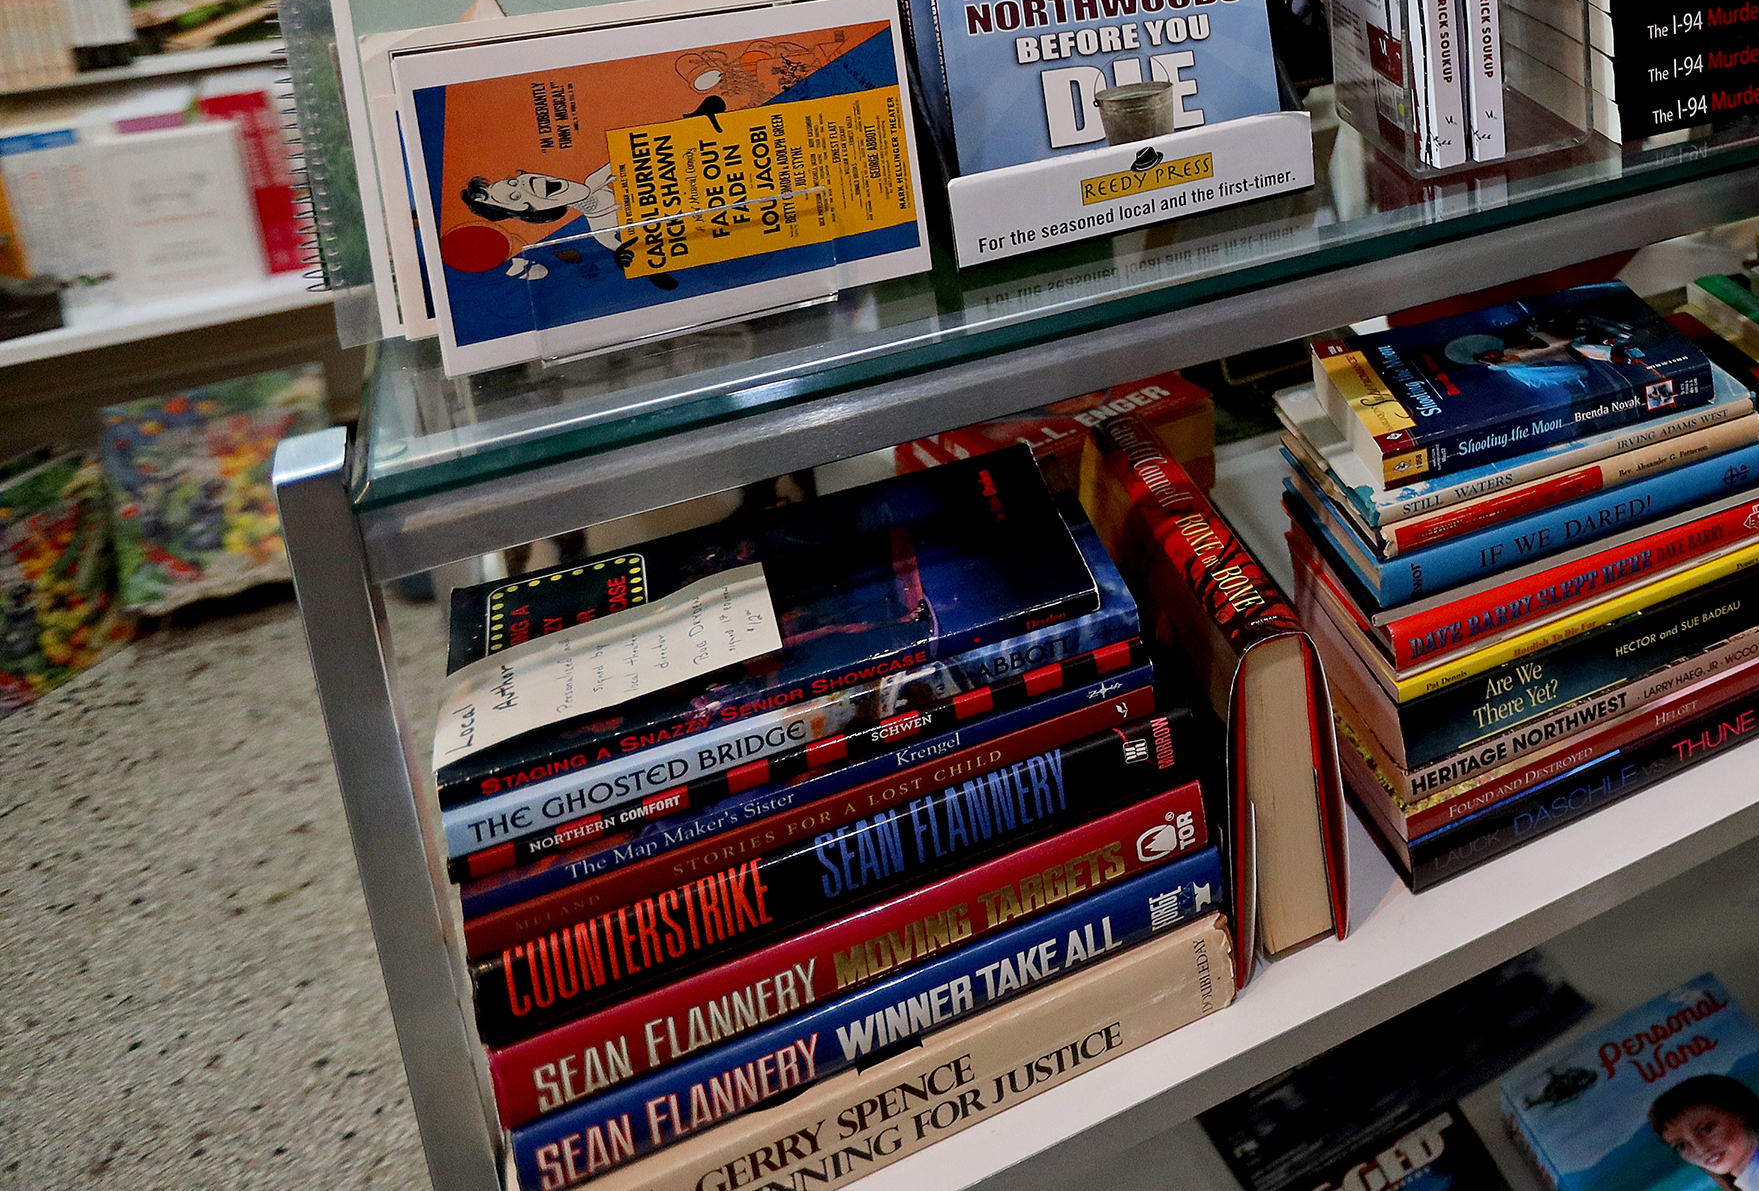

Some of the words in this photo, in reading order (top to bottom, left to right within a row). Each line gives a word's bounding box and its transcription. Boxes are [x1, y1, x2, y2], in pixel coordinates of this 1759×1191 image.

[1015, 23, 1141, 64] BEFORE
[1146, 13, 1211, 46] YOU
[1439, 30, 1453, 84] SOUKUP
[886, 96, 899, 139] THEATER
[1041, 50, 1205, 150] DIE
[629, 132, 657, 206] BURNETT
[653, 135, 682, 207] SHAWN
[699, 139, 722, 180] OUT
[723, 144, 742, 168] IN
[749, 125, 775, 191] JACOBI
[890, 139, 904, 187] HELLINGER
[1082, 174, 1151, 200] REEDY
[1154, 156, 1211, 185] PRESS
[706, 185, 731, 239] FADE
[727, 171, 751, 225] FADE
[760, 198, 781, 235] LOU
[895, 188, 906, 210] MARK
[978, 235, 1007, 254] For
[1010, 225, 1038, 245] the
[1041, 207, 1115, 240] seasoned
[1119, 198, 1156, 224] local
[1160, 191, 1188, 212] and
[1191, 185, 1216, 205] the
[1218, 169, 1297, 200] first-timer.
[641, 208, 666, 269] CAROL
[664, 210, 690, 258] DICK
[1458, 429, 1509, 457] Shooting
[1509, 424, 1530, 444] the
[1531, 416, 1563, 438] Moon
[1573, 404, 1610, 423] Brenda
[1612, 396, 1642, 413] Novak
[1402, 494, 1444, 517] STILL
[1455, 473, 1513, 500] WATERS
[1409, 622, 1463, 659] DAVE
[1466, 594, 1533, 632] BARRY
[1536, 569, 1598, 610] SLEPT
[1603, 549, 1652, 584] HERE
[491, 664, 516, 711] Author
[1473, 697, 1525, 730] There
[1527, 678, 1560, 707] Yet?
[1485, 674, 1513, 700] Are
[1516, 662, 1544, 683] We
[445, 702, 476, 755] Local
[480, 753, 587, 797] STAGING
[596, 747, 612, 762] A
[620, 715, 711, 754] SNAZZY
[720, 687, 804, 722] SENIOR
[811, 651, 928, 694] SHOWCASE
[1411, 742, 1508, 796] HERITAGE
[1512, 691, 1628, 754] NORTHWEST
[1672, 710, 1756, 761] THUNE
[468, 807, 534, 845] THE
[541, 757, 689, 820] GHOSTED
[699, 718, 807, 772] BRIDGE
[529, 816, 616, 855] NORTHERN
[619, 795, 681, 823] COMFORT
[565, 860, 612, 881] The
[614, 839, 659, 865] Map
[663, 811, 739, 850] Maker's
[743, 792, 796, 819] Sister
[503, 857, 774, 1018] COUNTERSTRIKE
[814, 807, 906, 899] SEAN
[909, 748, 1068, 865] FLANNERY
[533, 1035, 635, 1113] SEAN
[643, 958, 818, 1068] FLANNERY
[833, 900, 973, 990] MOVING
[976, 840, 1127, 930] TARGETS
[1179, 811, 1196, 850] TOR
[536, 1113, 636, 1191] SEAN
[645, 1032, 820, 1146] FLANNERY
[836, 980, 974, 1062] WINNER
[976, 938, 1060, 1001] TAKE
[1065, 915, 1123, 973] ALL
[1597, 991, 1729, 1082] Personal
[1632, 1033, 1720, 1086] Wars
[913, 1087, 987, 1141] FOR
[991, 1021, 1124, 1105] JUSTICE
[696, 1120, 825, 1191] GERRY
[837, 1054, 977, 1141] SPENCE
